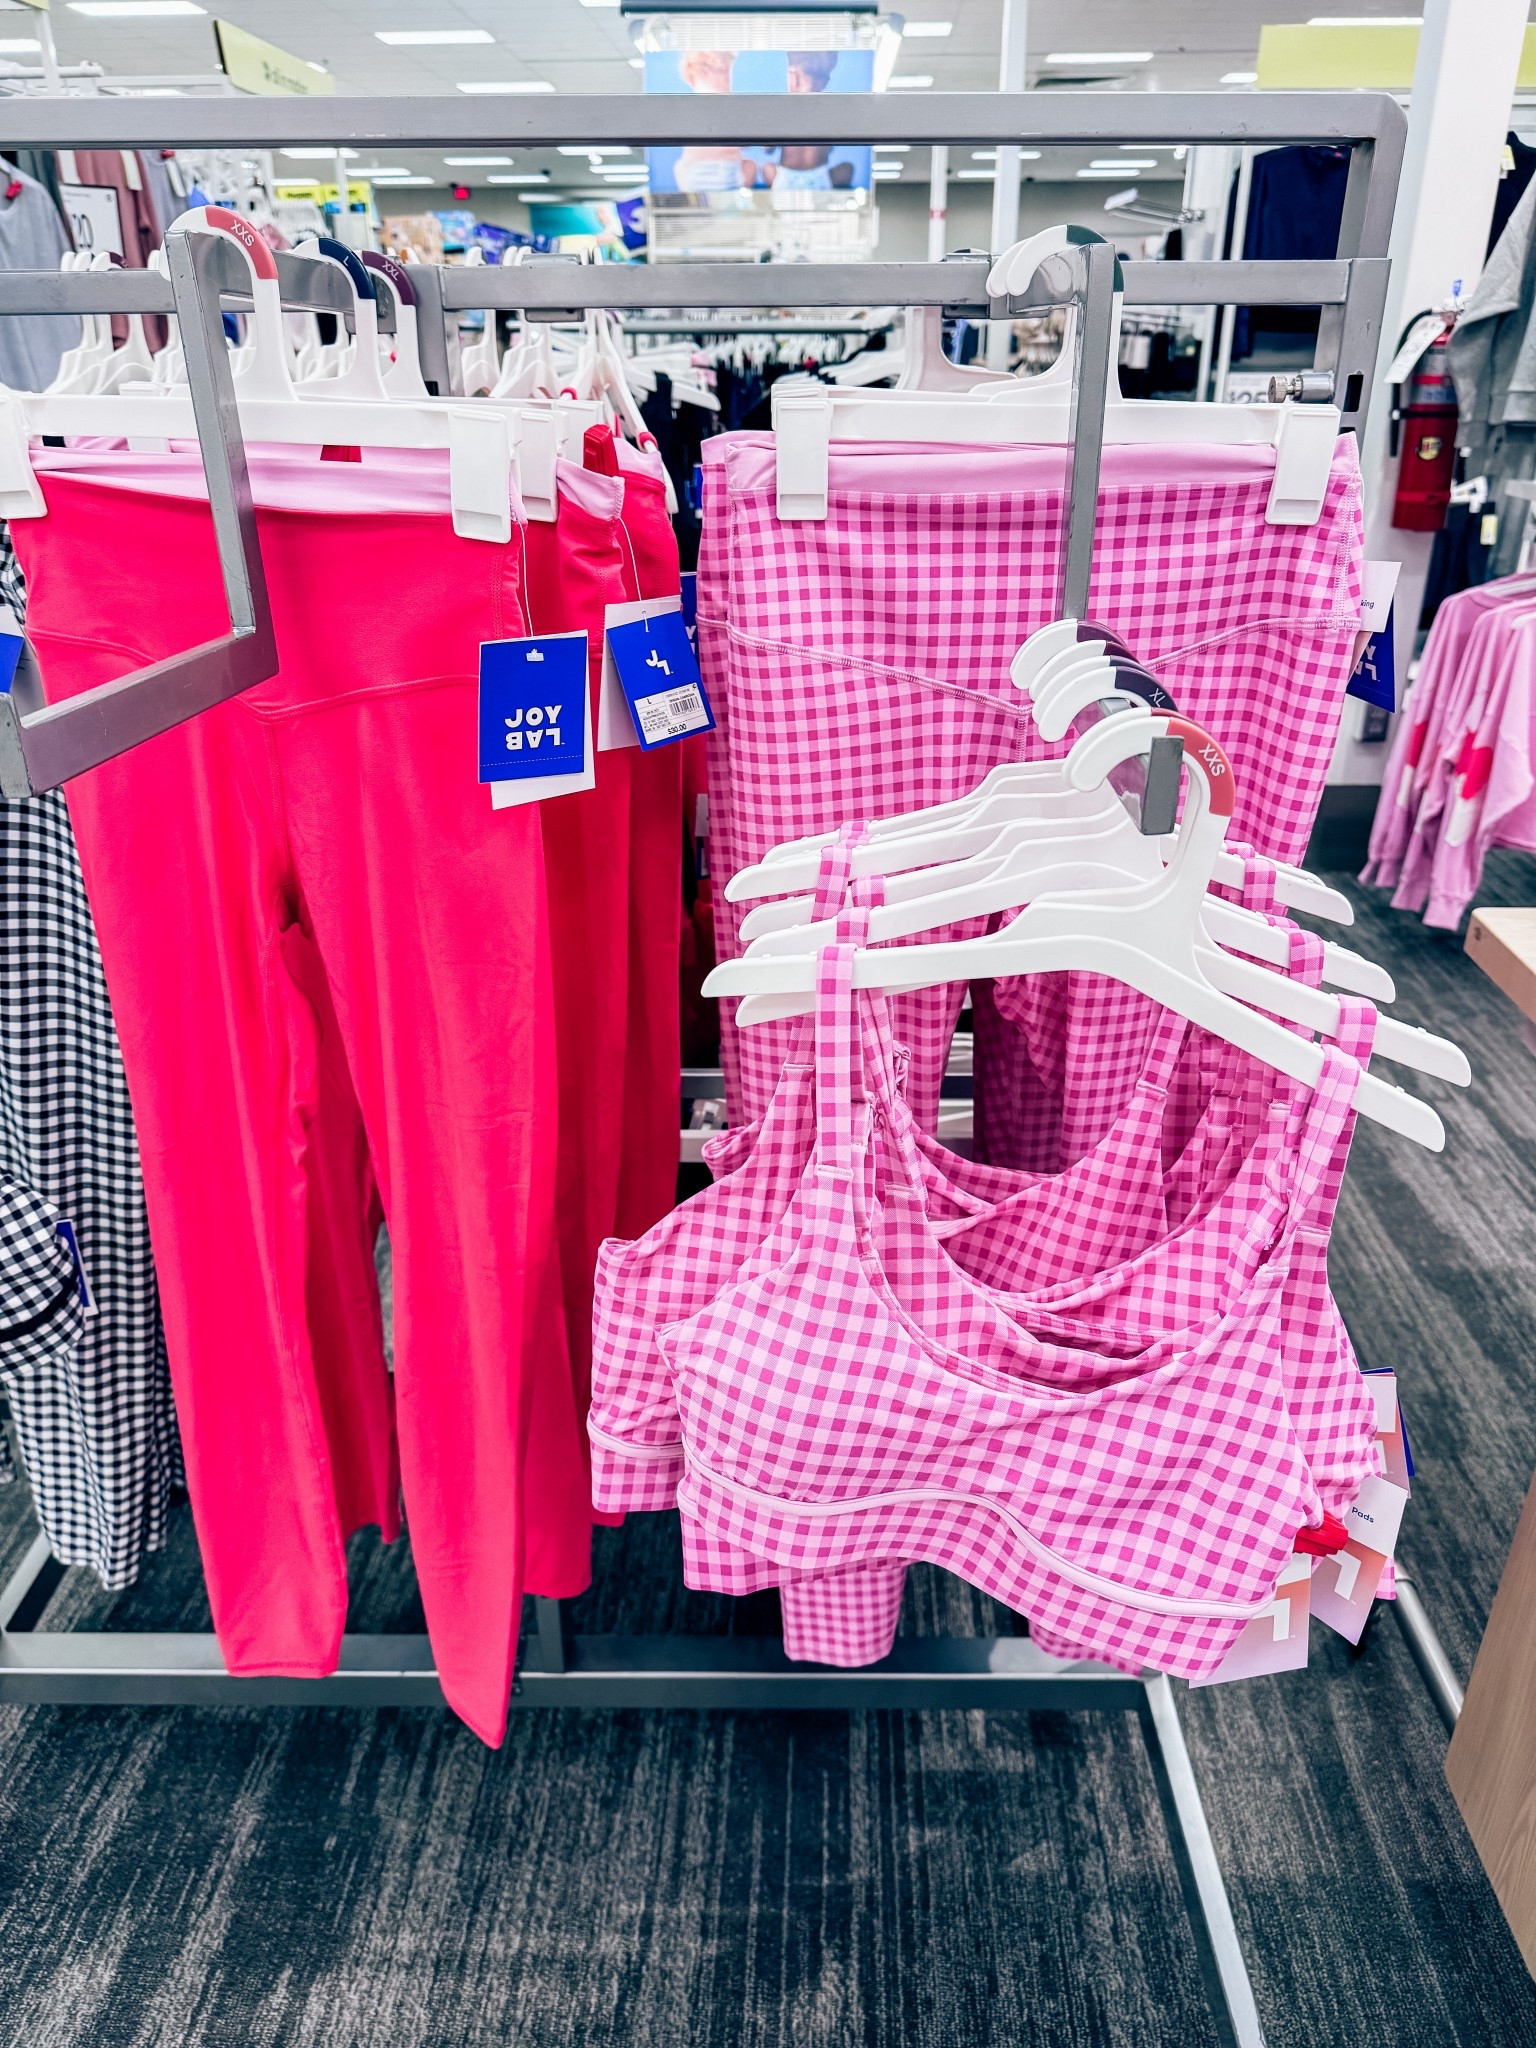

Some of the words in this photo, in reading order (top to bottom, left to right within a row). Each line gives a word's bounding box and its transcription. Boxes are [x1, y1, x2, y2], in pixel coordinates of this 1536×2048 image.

[231, 219, 255, 247] XXS
[342, 255, 350, 266] L
[381, 260, 400, 281] XXL
[1148, 687, 1166, 708] XL
[504, 704, 563, 729] JOY
[505, 727, 561, 751] LAB
[667, 723, 687, 735] $30.00
[1198, 742, 1226, 777] XXS
[1351, 1506, 1375, 1523] Pads
